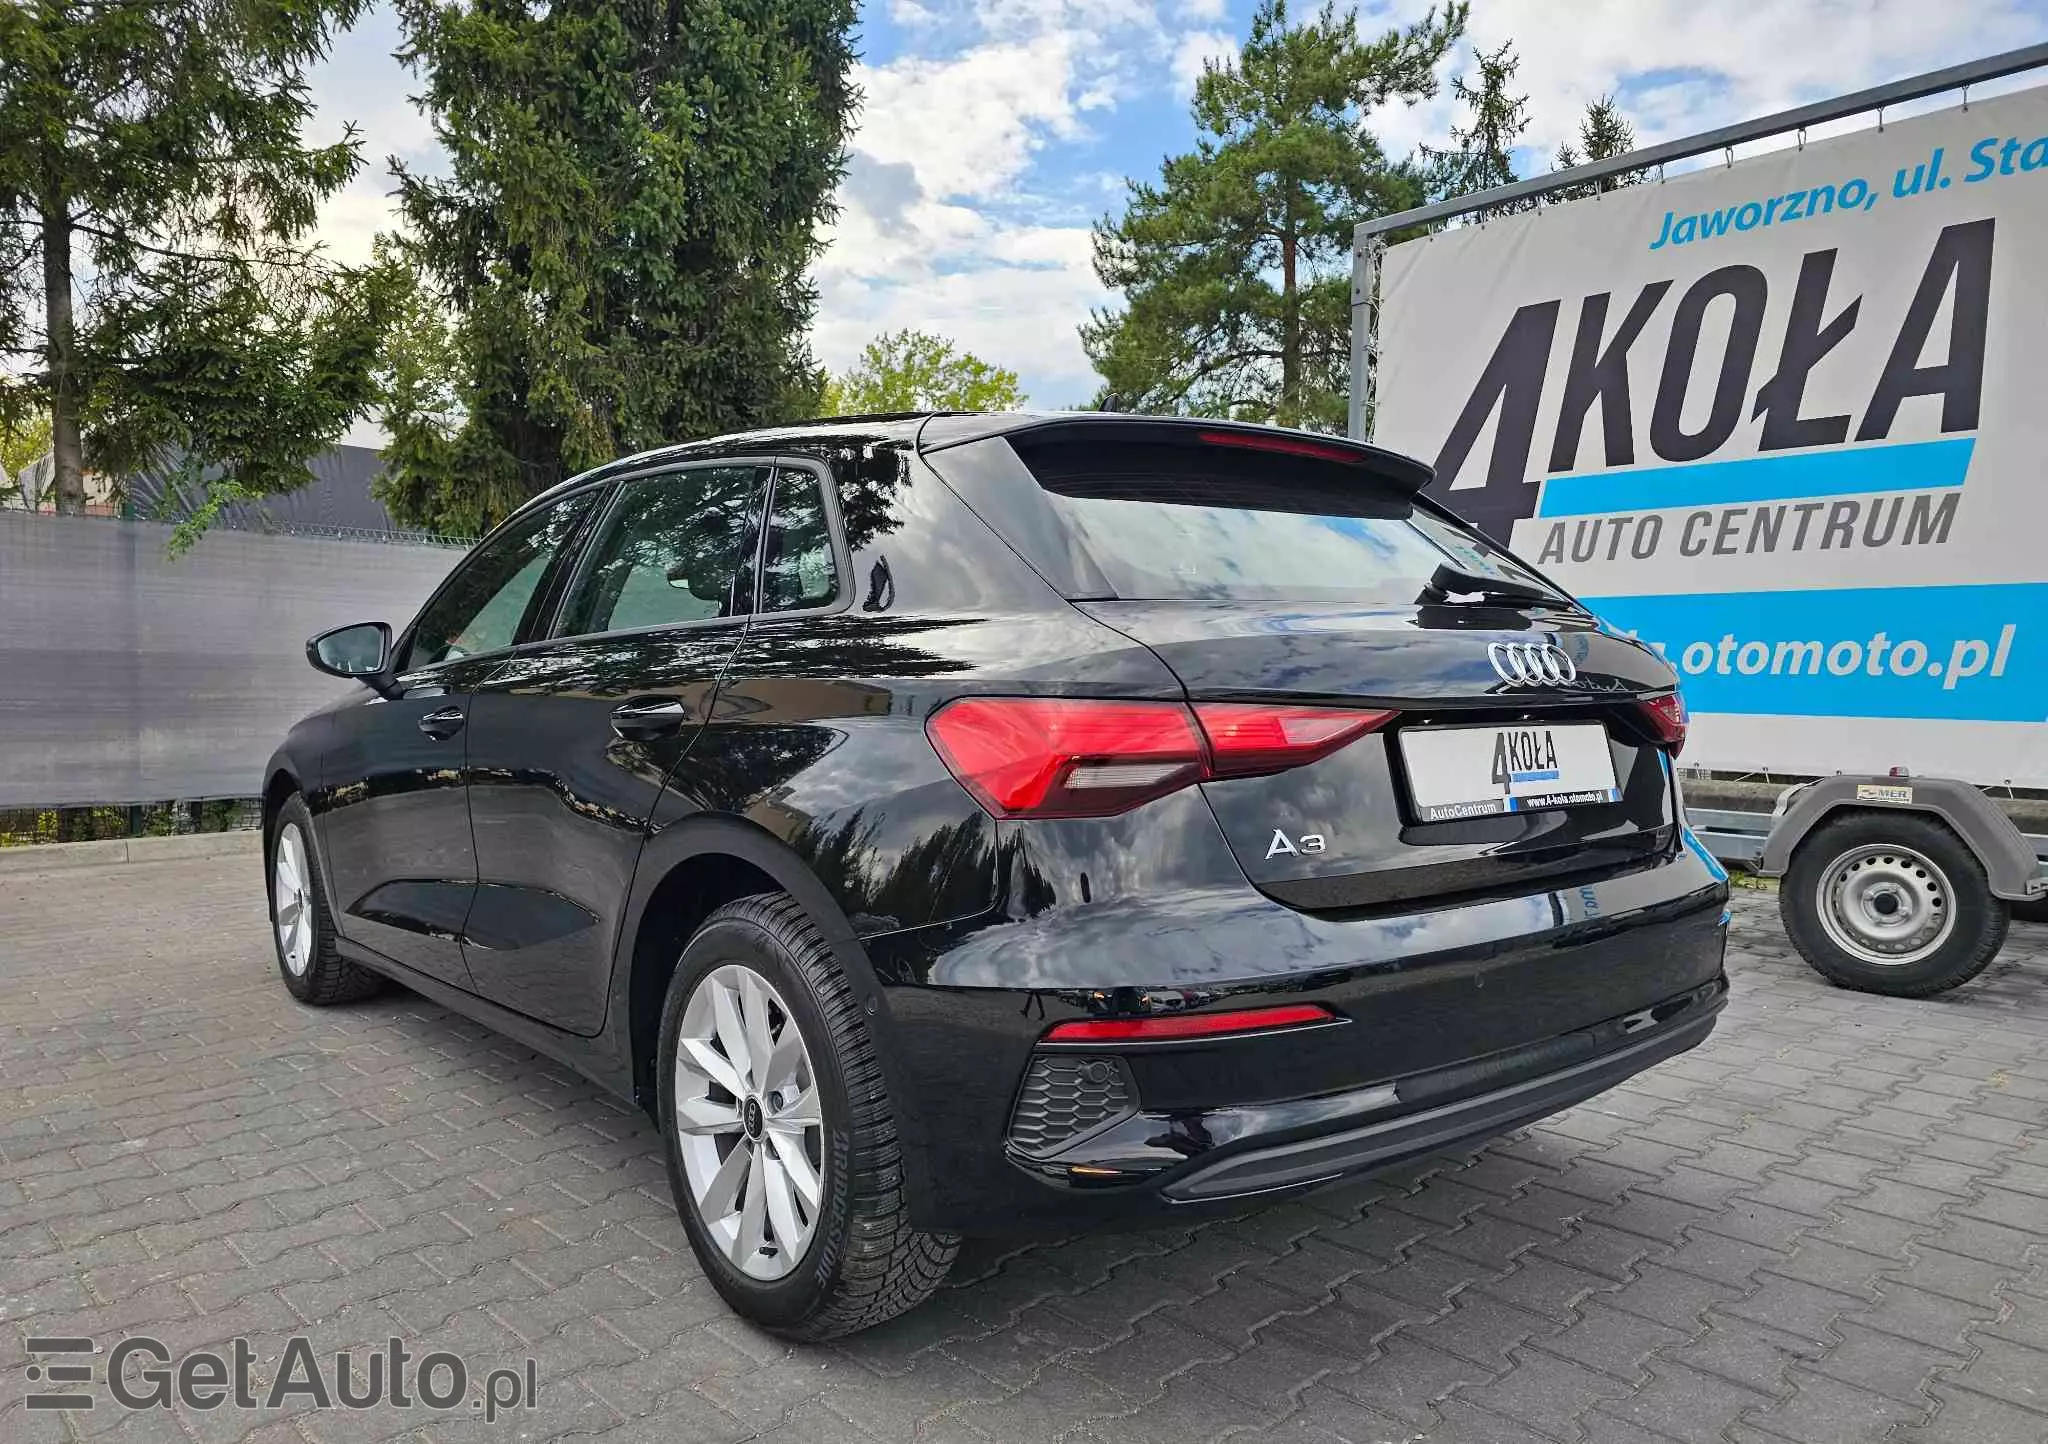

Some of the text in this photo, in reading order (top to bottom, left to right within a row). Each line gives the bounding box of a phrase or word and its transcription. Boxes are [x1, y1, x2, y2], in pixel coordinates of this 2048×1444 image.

[1649, 178, 1880, 250] Jaworzno,
[1892, 147, 1952, 199] ul.
[1537, 492, 1961, 565] AUTO CENTRUM
[1430, 803, 1497, 820] AutoCentrum
[1264, 828, 1327, 860] A3
